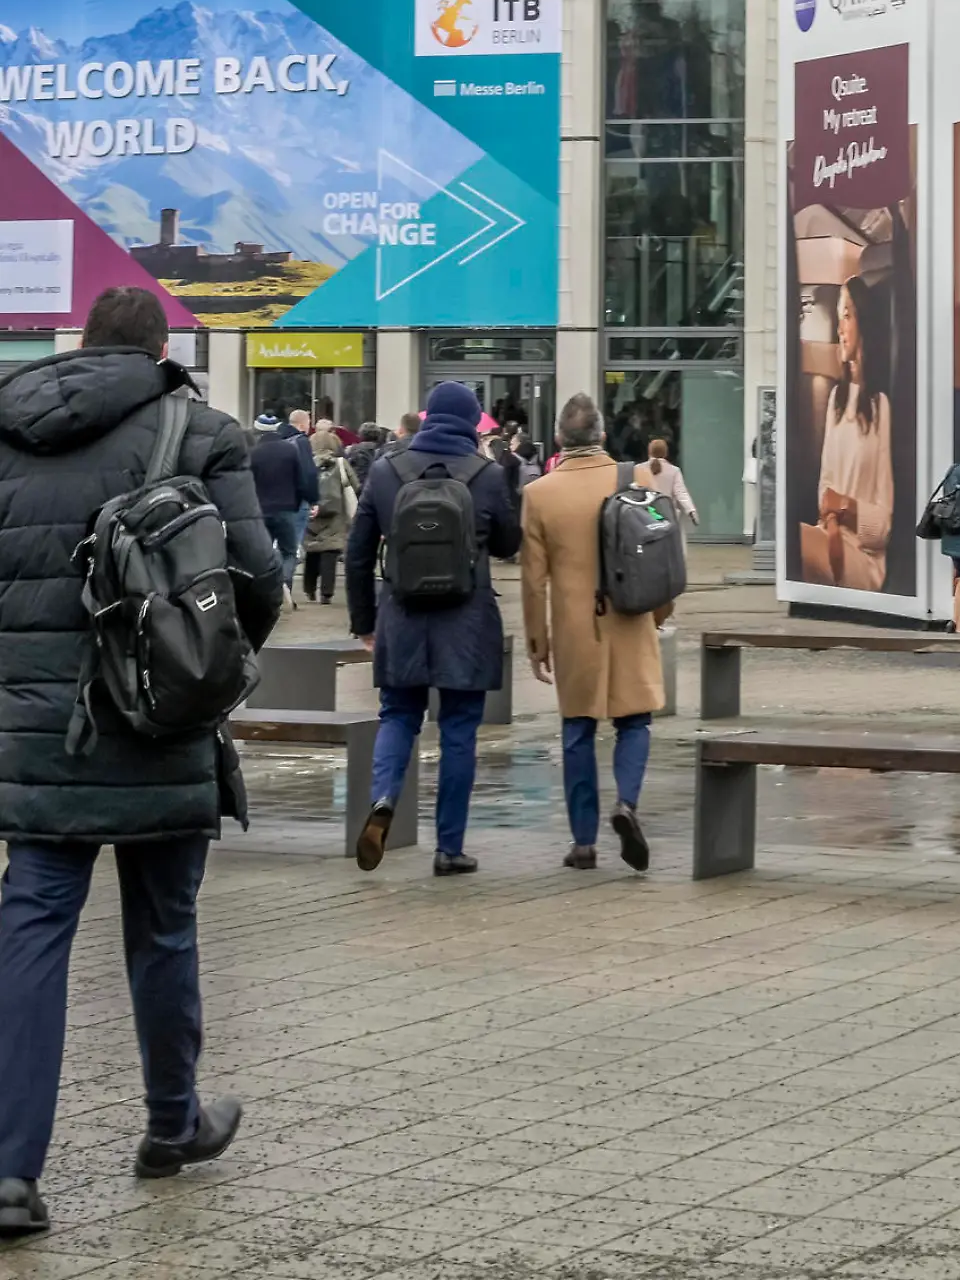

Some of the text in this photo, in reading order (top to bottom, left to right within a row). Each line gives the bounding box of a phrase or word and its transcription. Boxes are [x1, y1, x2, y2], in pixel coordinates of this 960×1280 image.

[492, 29, 541, 45] BERLIN
[0, 54, 350, 102] WELCOME BACK,
[460, 81, 546, 96] Messe Berlin
[823, 108, 841, 135] My
[47, 117, 197, 158] WORLD
[323, 191, 421, 220] OPEN FOR
